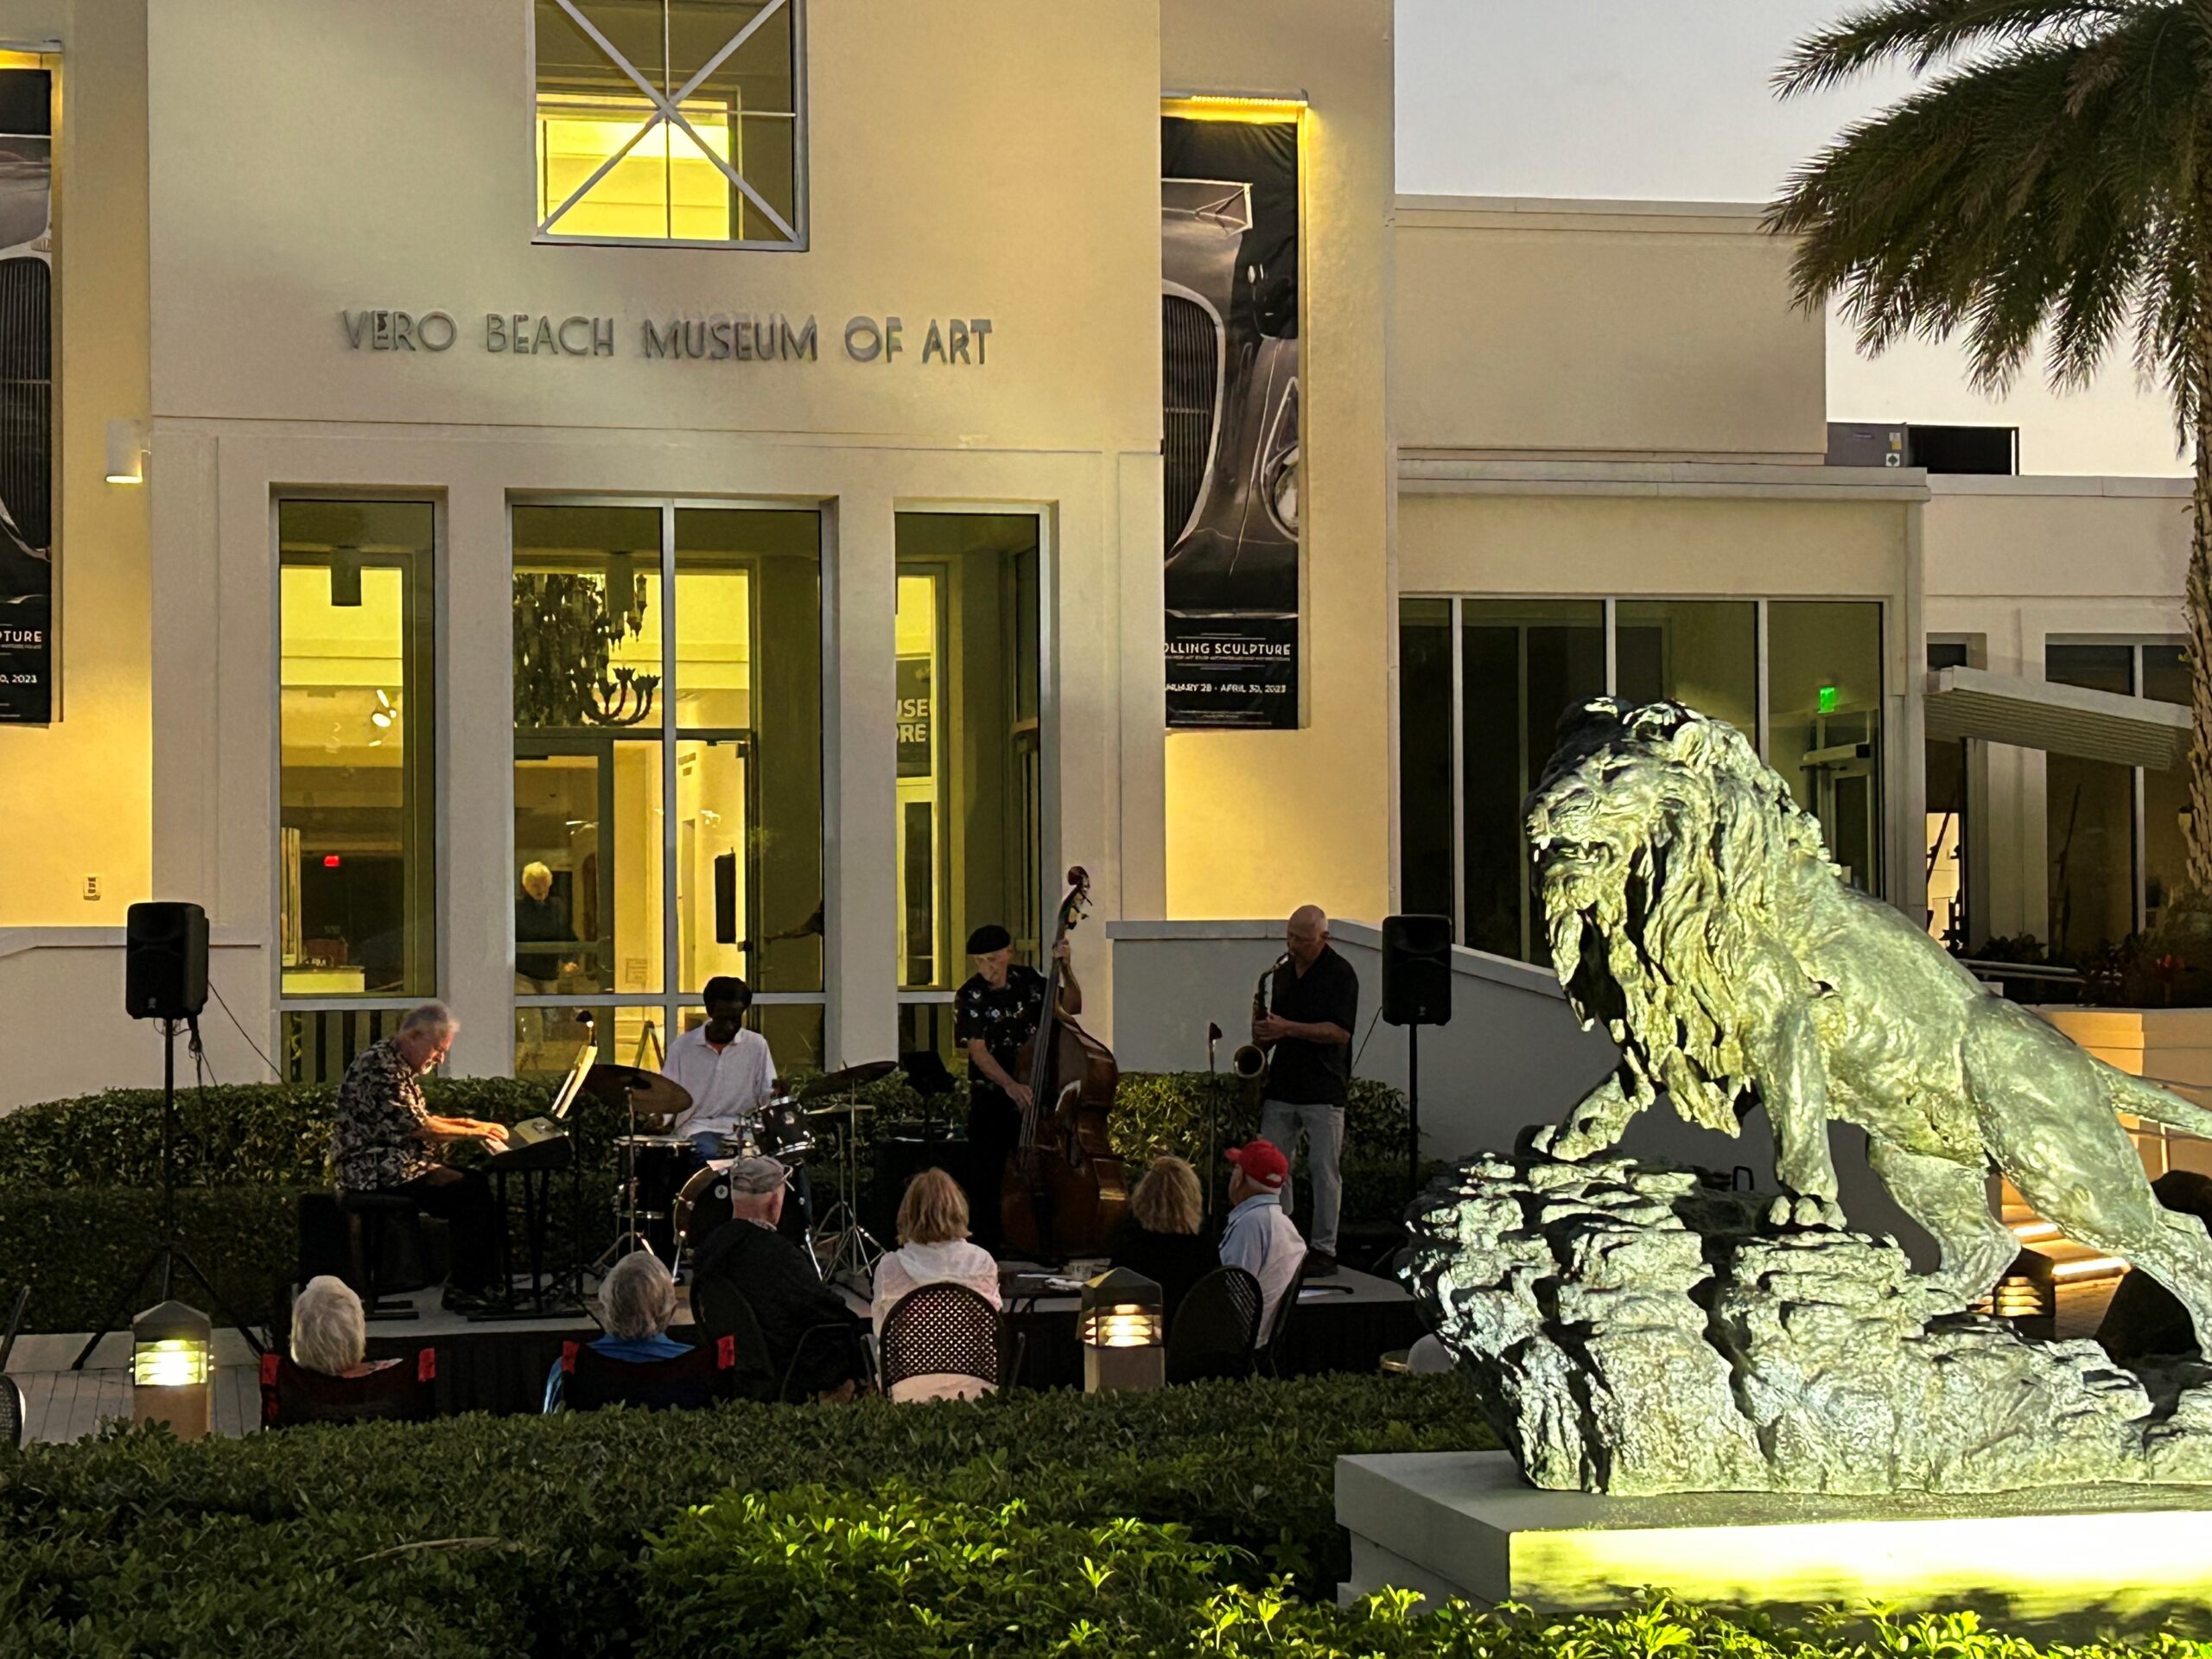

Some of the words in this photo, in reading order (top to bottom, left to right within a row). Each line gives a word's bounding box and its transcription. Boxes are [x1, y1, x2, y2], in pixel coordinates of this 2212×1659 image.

[341, 310, 457, 352] VERO
[486, 314, 614, 357] BEACH
[642, 315, 818, 363] MUSEUM
[845, 315, 903, 364] OF
[922, 318, 993, 365] ART
[0, 631, 42, 642] TURE
[1215, 643, 1291, 655] SCULPTURE
[11, 674, 38, 683] 2023
[1220, 683, 1247, 693] APRIL
